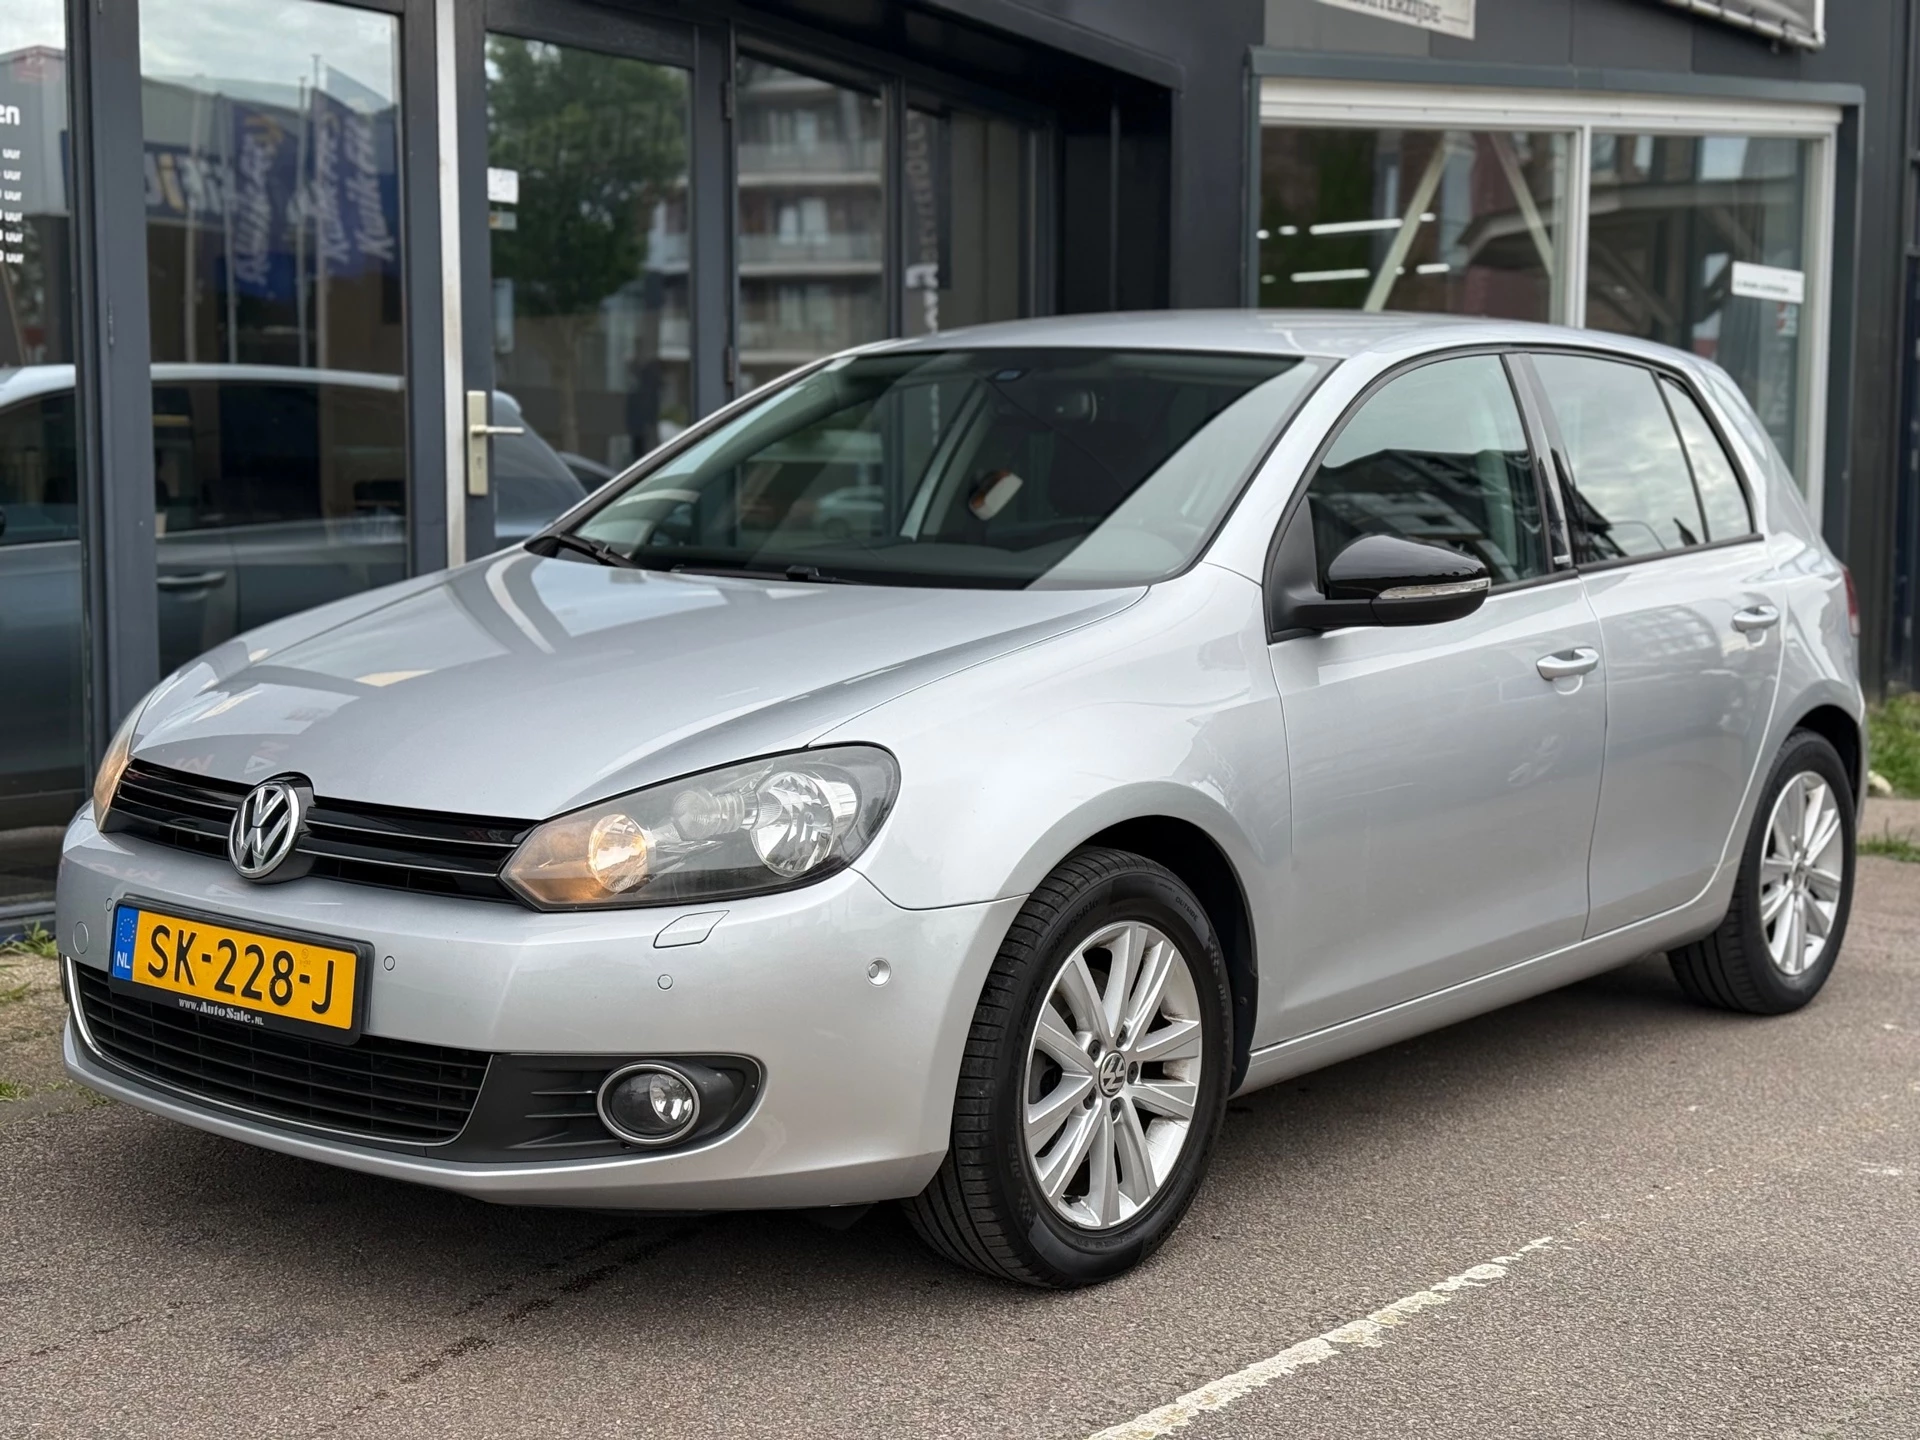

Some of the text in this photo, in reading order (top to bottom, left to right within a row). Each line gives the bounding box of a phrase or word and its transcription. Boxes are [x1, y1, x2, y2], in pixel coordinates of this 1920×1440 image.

[2, 149, 21, 160] uur
[3, 170, 22, 181] uur
[4, 190, 22, 201] uur
[4, 211, 23, 222] uur
[5, 232, 24, 243] uur
[6, 253, 24, 264] uur
[1175, 896, 1199, 922] OUTSIDE
[116, 951, 130, 970] NL
[147, 924, 335, 1015] SK-228-J
